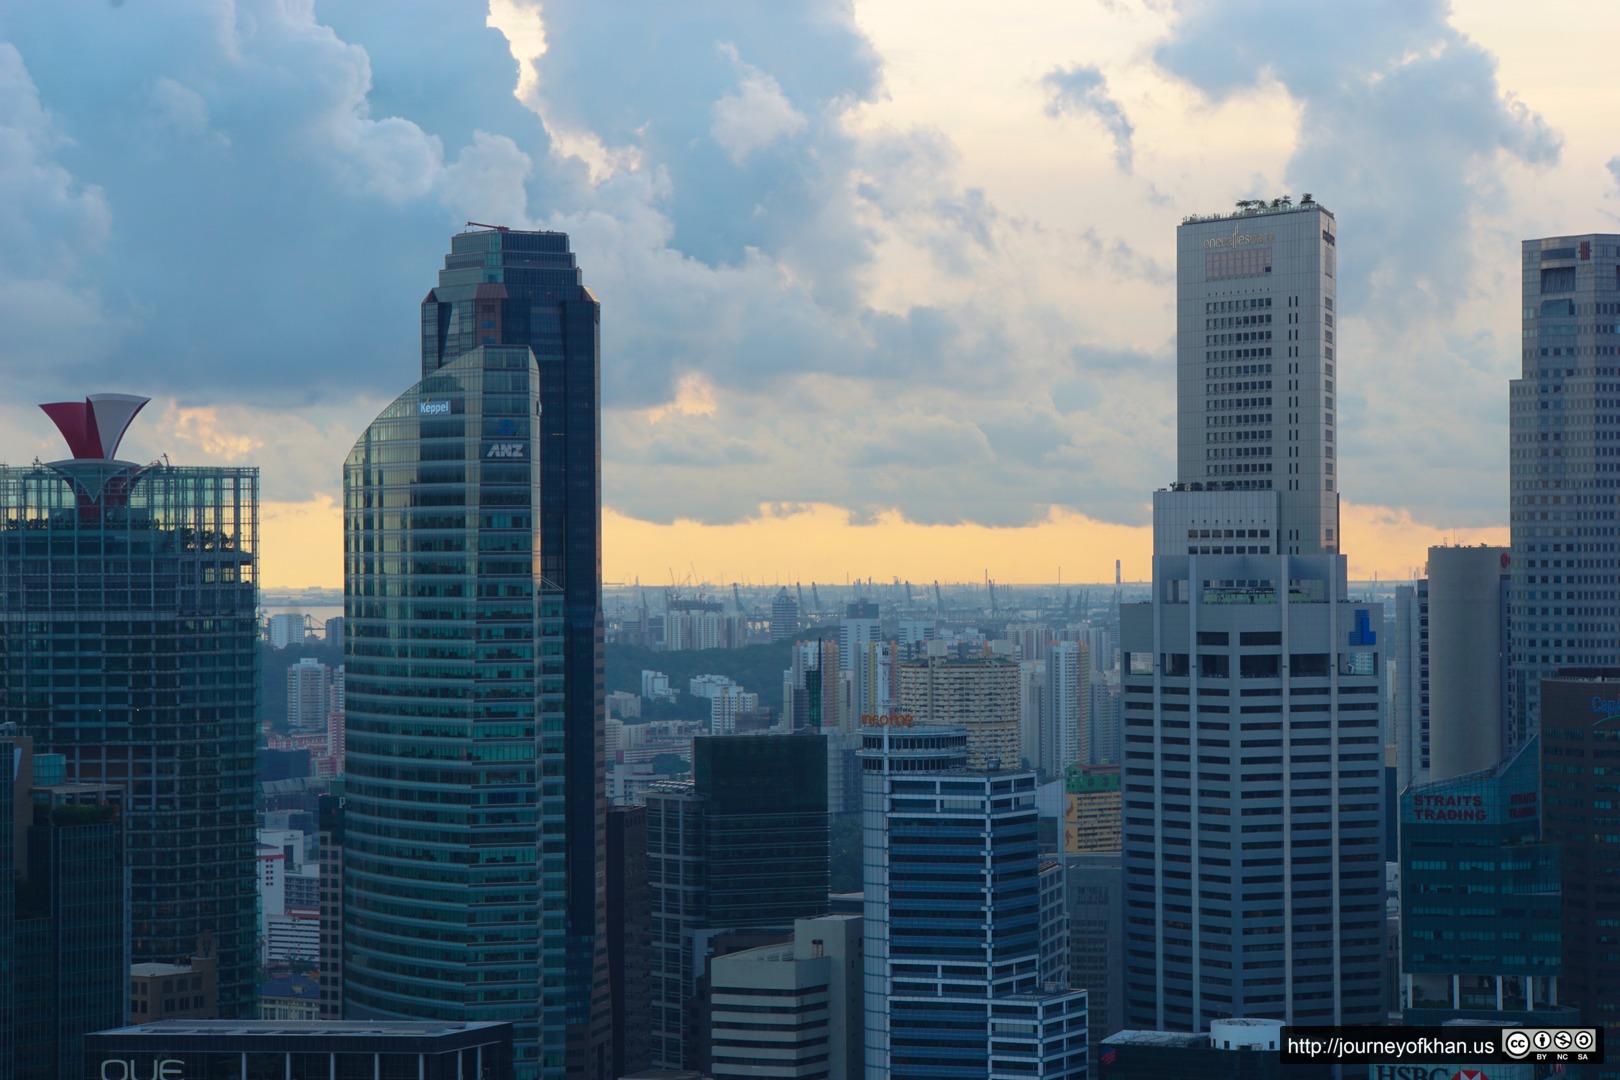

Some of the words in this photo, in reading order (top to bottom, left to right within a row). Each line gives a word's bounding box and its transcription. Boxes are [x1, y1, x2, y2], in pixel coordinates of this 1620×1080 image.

[420, 402, 449, 414] Keppel
[486, 443, 523, 457] ANZ
[1413, 795, 1483, 807] STRAITS
[1414, 810, 1487, 821] TRADING
[1375, 1064, 1449, 1080] HSBC
